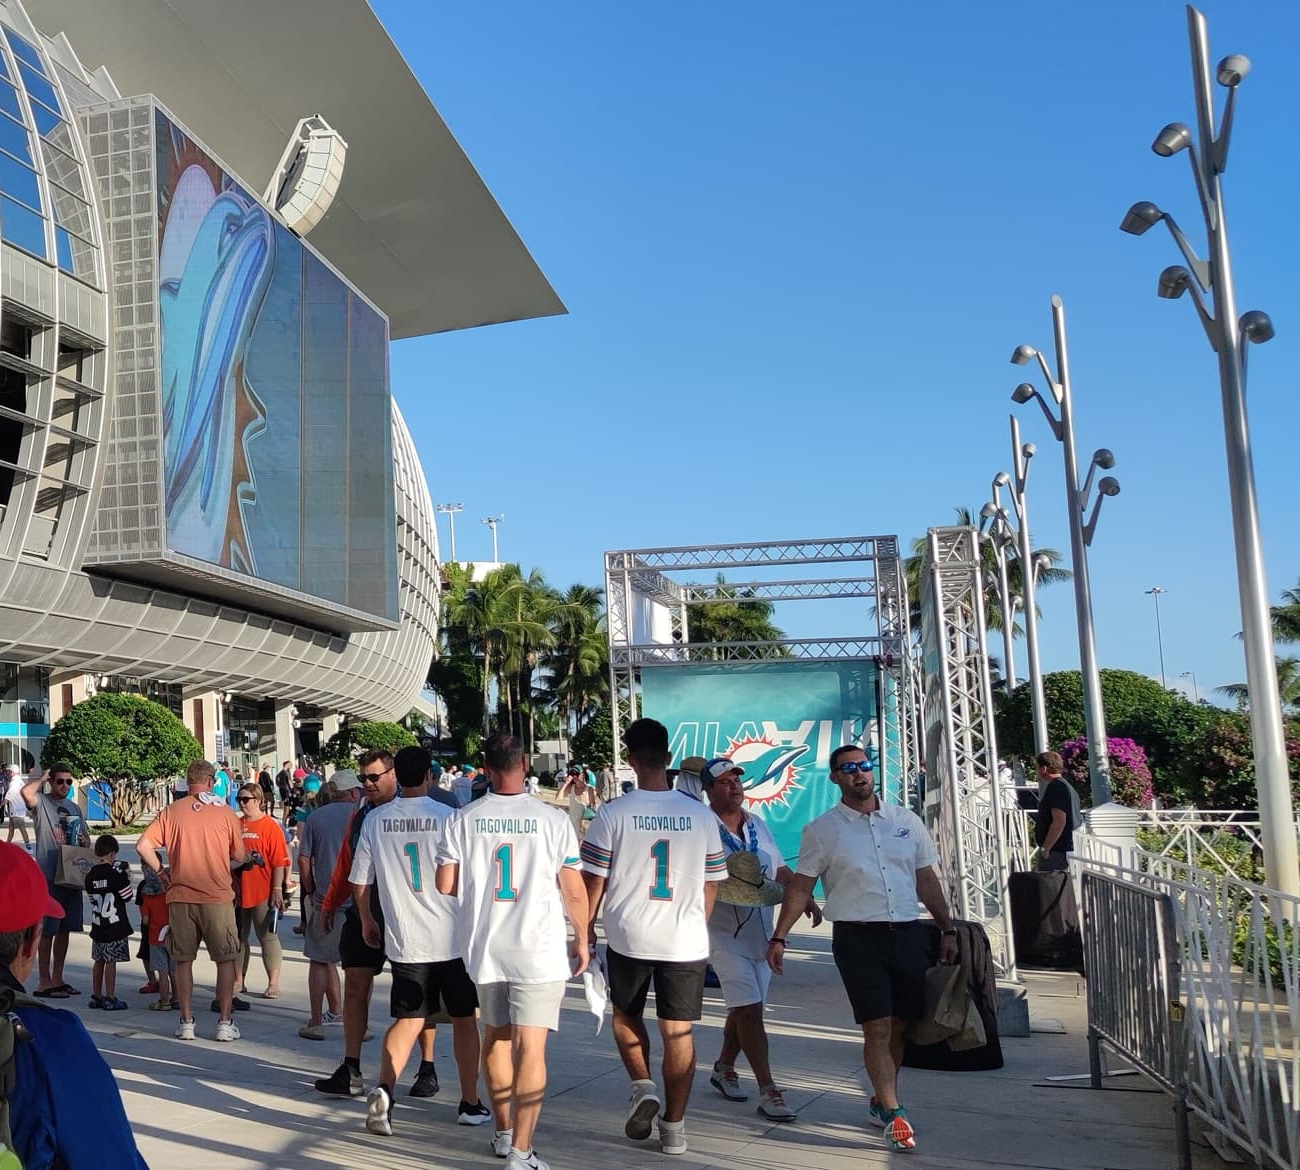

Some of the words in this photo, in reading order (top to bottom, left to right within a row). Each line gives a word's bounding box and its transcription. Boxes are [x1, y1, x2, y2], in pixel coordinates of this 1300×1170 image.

[382, 817, 438, 833] TAGOVAILOA
[475, 818, 538, 834] TAGOVAILOA
[633, 815, 692, 831] TAGOVAILOA
[403, 841, 422, 893] 1
[495, 842, 517, 902] 1
[649, 838, 673, 901] 1
